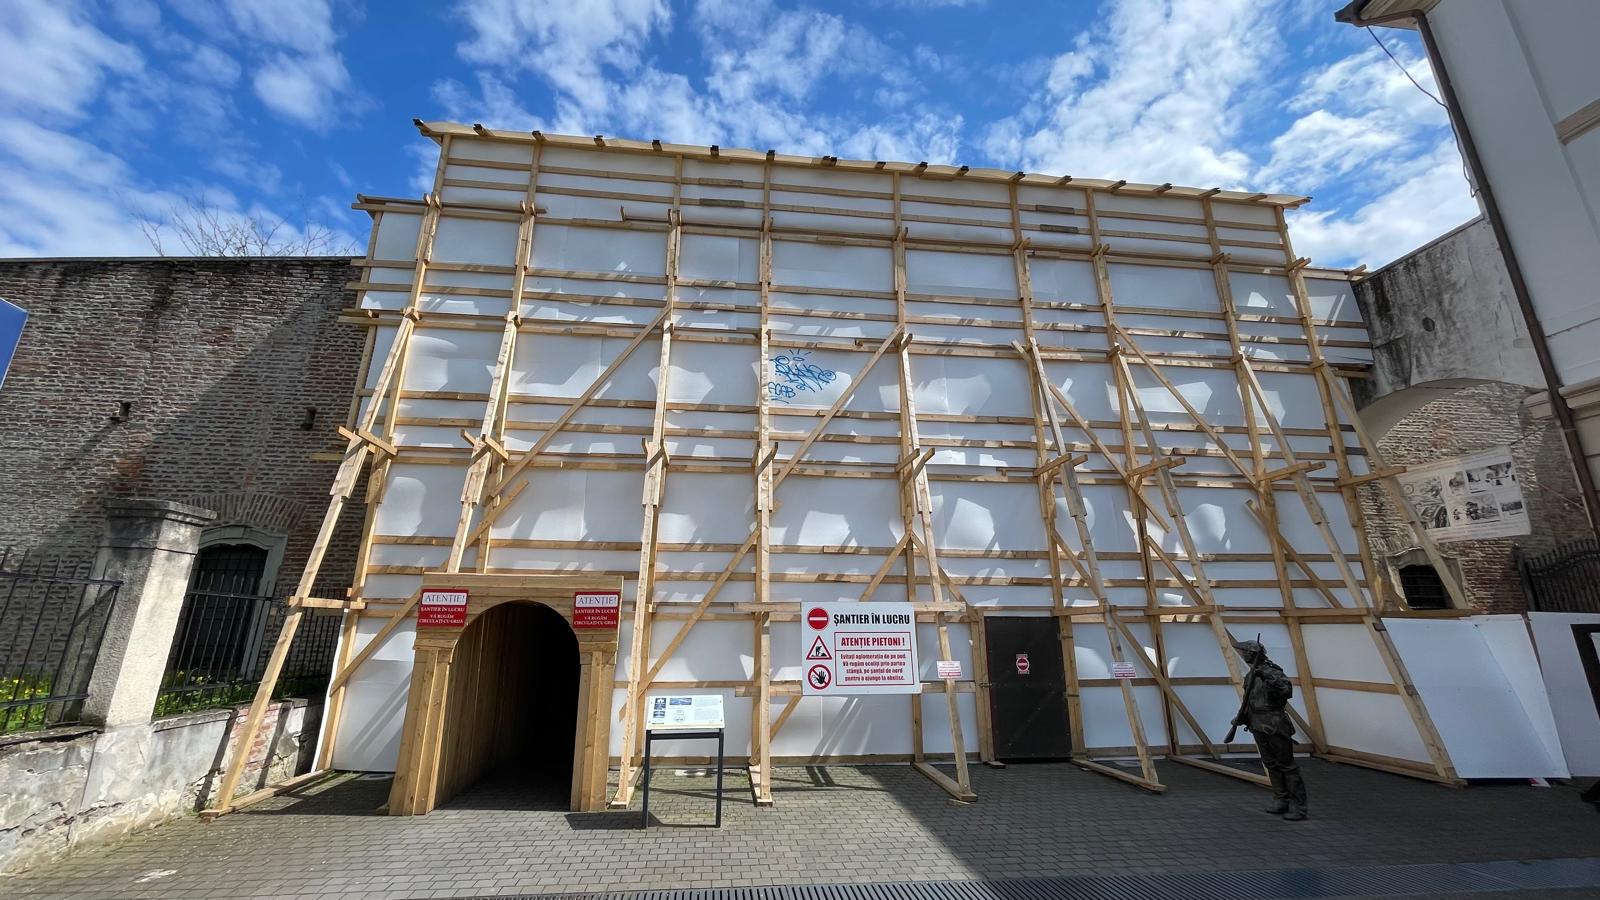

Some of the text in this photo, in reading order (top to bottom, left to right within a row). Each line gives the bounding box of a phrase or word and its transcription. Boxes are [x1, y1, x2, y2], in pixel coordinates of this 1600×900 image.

[424, 594, 465, 603] ATENȚIE!
[577, 596, 617, 606] ATENȚIE!
[834, 612, 910, 626] ȘANTIER ÎN LUCRU
[841, 638, 870, 648] ATENȚIE
[872, 638, 900, 646] PIETONI
